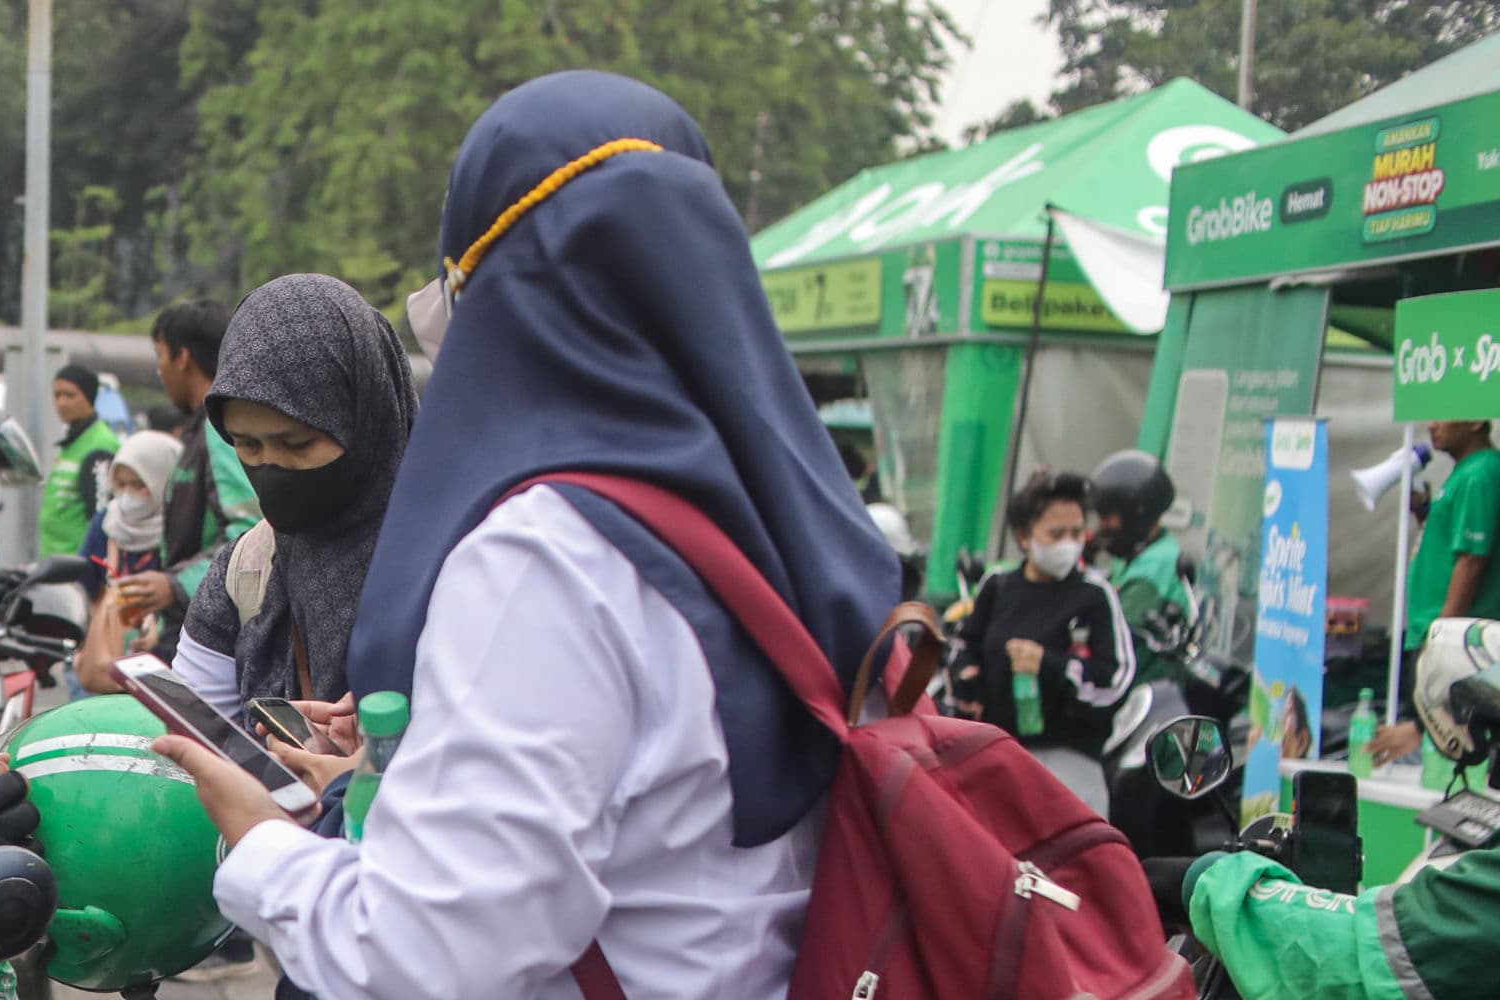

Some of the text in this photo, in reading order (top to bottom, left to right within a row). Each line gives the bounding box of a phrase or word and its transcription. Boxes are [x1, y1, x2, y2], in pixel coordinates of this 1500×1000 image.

[1373, 142, 1436, 181] MURAH
[1285, 186, 1325, 216] Hemat
[1363, 169, 1444, 213] NON-STOP
[1188, 190, 1273, 245] GrabBike
[1399, 331, 1447, 385] Grab
